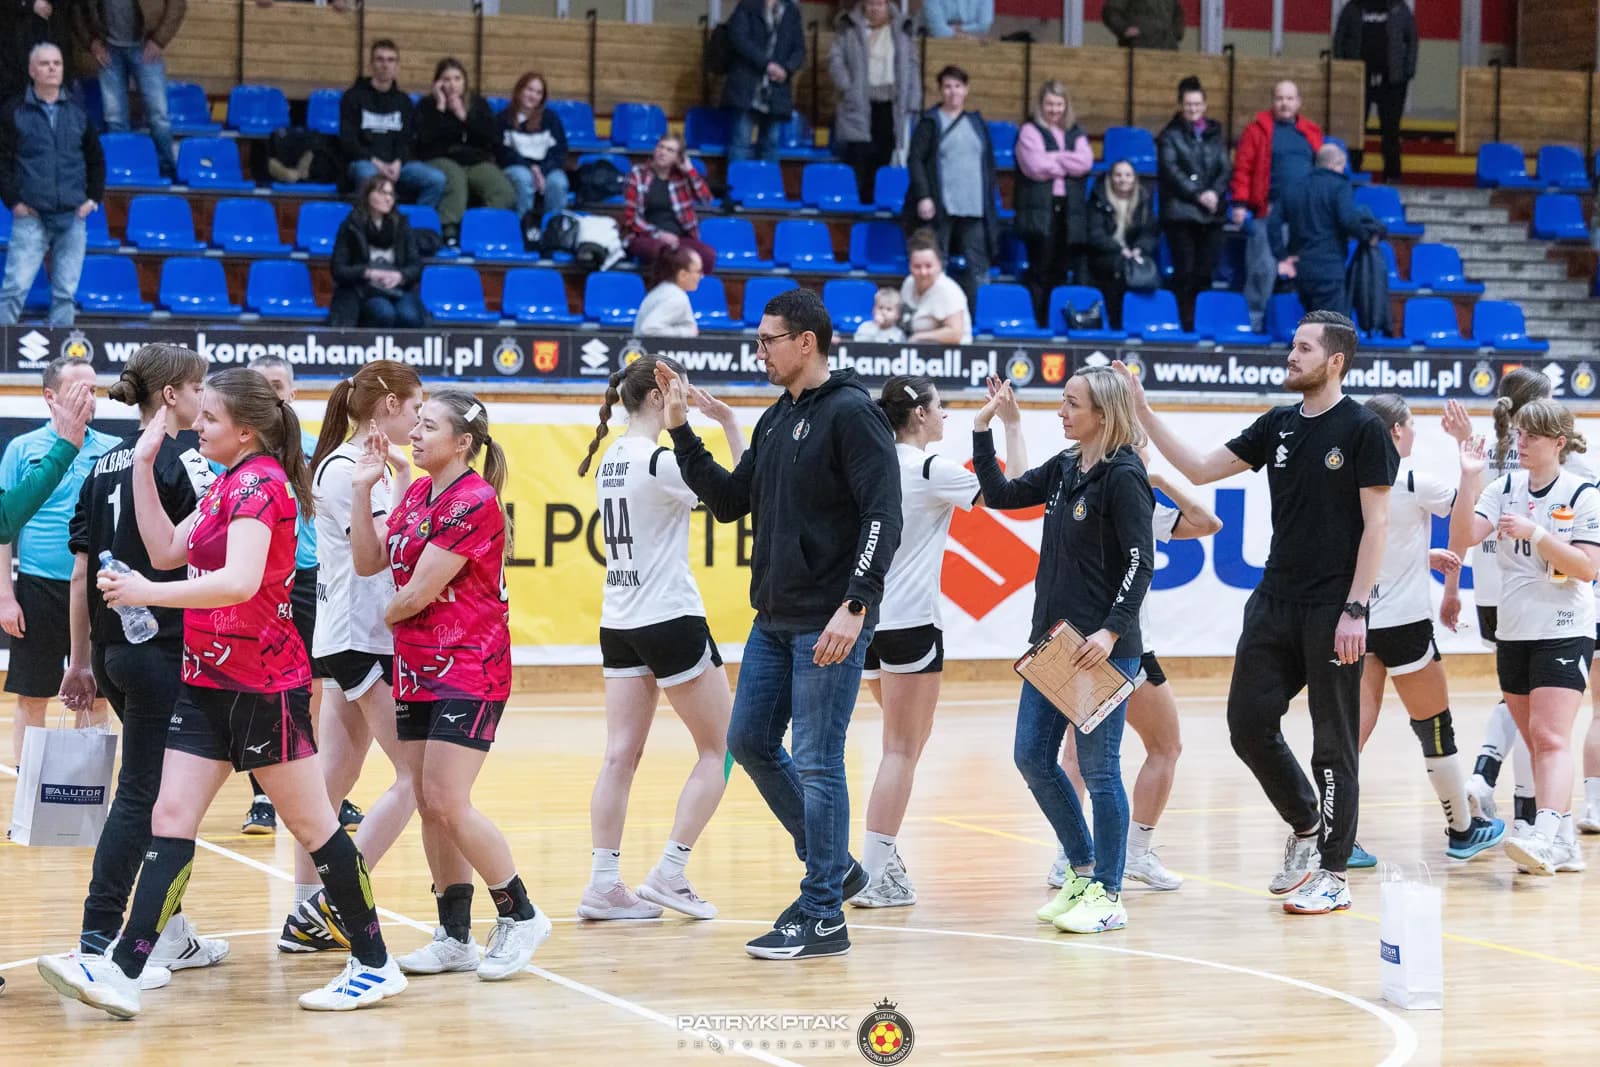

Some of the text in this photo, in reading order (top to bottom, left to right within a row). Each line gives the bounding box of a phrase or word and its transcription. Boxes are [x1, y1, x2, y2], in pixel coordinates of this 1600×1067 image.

[104, 333, 483, 376] wkoronahandball.pl
[107, 483, 121, 532] 1
[229, 486, 269, 501] PROFIKA
[603, 497, 634, 560] 44
